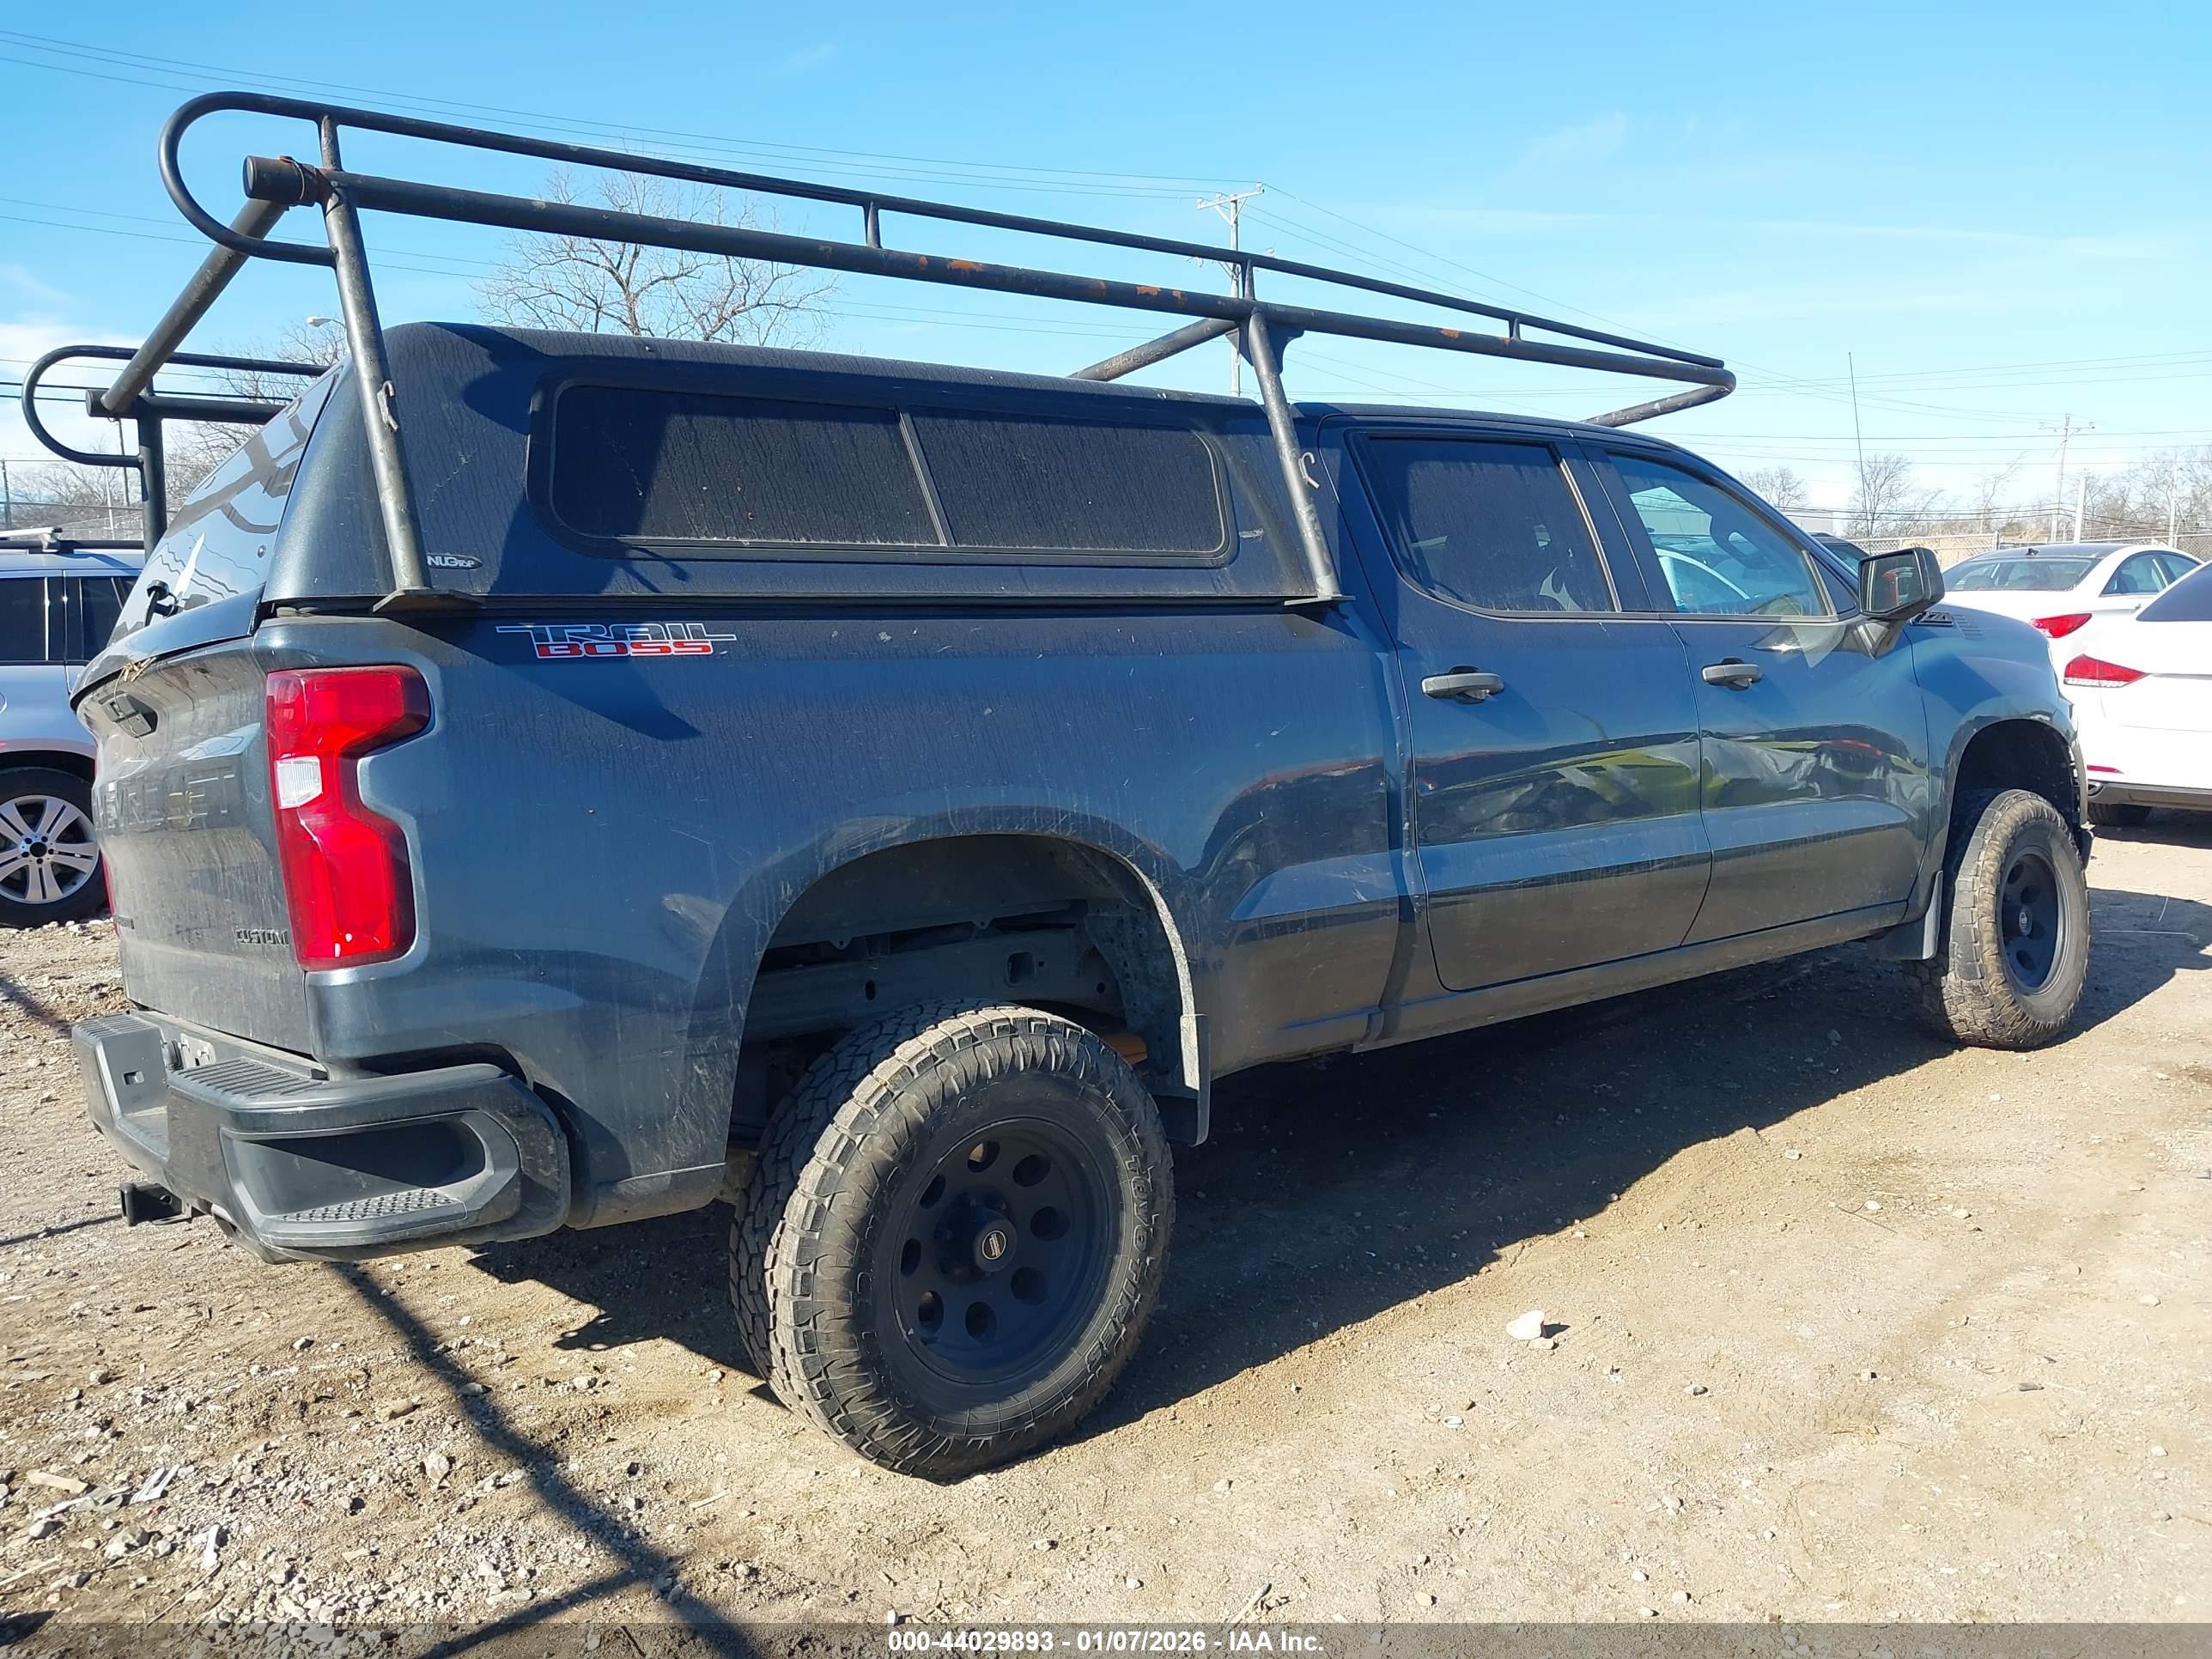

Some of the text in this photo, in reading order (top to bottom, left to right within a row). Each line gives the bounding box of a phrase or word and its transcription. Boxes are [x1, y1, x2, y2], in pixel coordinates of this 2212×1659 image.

[427, 556, 474, 567] NUGTOP
[495, 623, 737, 642] TRAIL
[537, 641, 713, 659] BOSS
[235, 929, 289, 945] CUSTOM
[1085, 1155, 1152, 1373] TOYO TIRES
